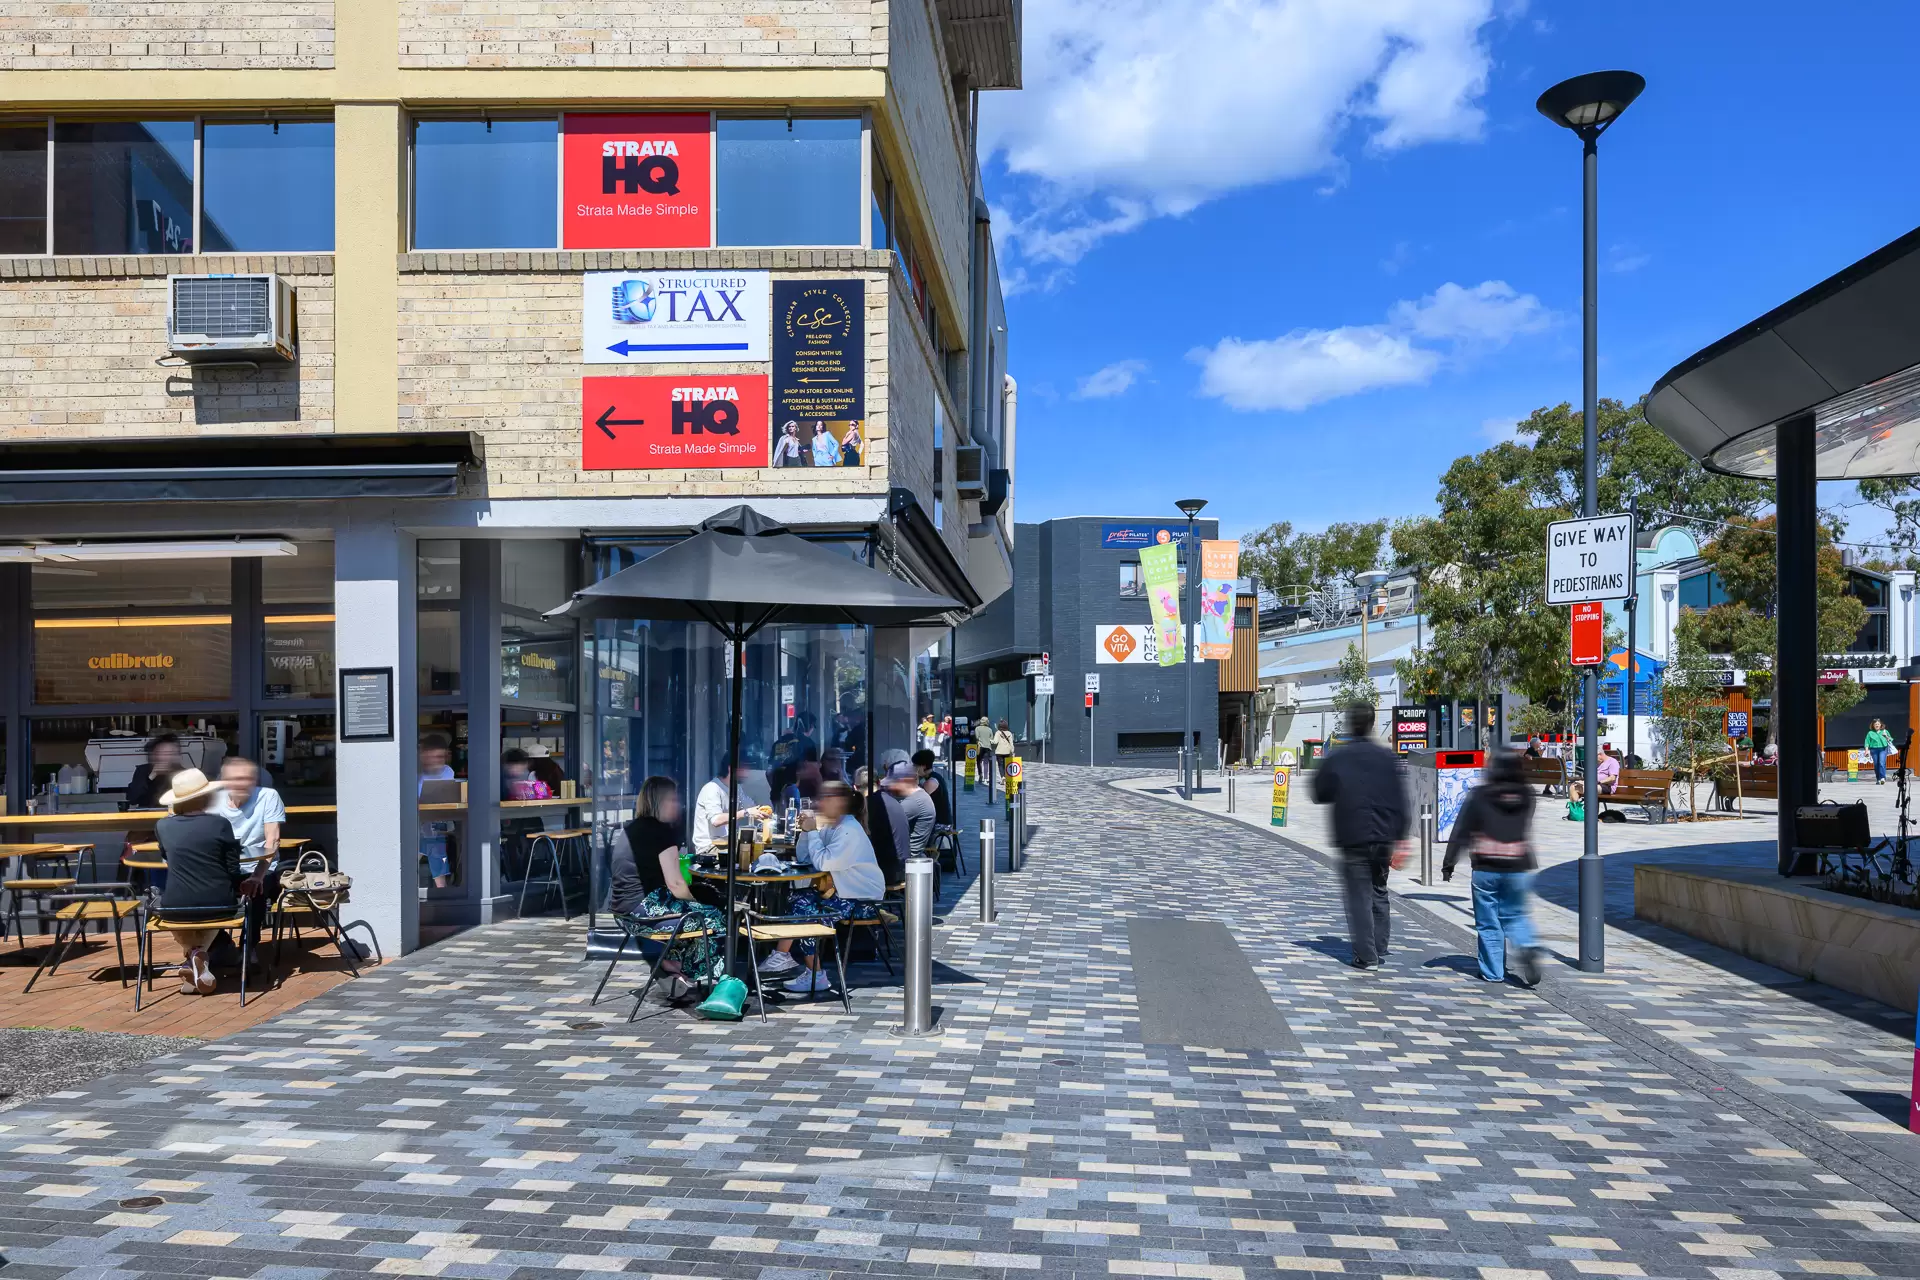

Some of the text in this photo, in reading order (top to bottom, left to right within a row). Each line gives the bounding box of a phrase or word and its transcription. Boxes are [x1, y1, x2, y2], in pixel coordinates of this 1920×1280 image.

[602, 140, 679, 156] STRATA
[602, 155, 680, 196] HQ
[577, 203, 698, 217] Strata Made Simple
[658, 290, 747, 322] TAX
[786, 289, 850, 338] CIRCULAR STYLE COLLECTIVE
[672, 387, 739, 401] STRATA
[672, 400, 740, 436] HQ
[649, 442, 756, 455] Strata Made Simple
[1554, 525, 1626, 547] GIVE WAY
[1580, 552, 1597, 568] TO
[1554, 574, 1623, 594] PEDESTRIANS
[1575, 614, 1599, 622] STOPPING
[1112, 634, 1128, 643] GO
[1110, 644, 1130, 652] VITA
[88, 652, 174, 669] calibrate
[522, 652, 556, 670] calibrate
[98, 674, 166, 682] BIRDWOOD
[1826, 672, 1844, 681] Delight
[1398, 723, 1426, 732] coles
[1009, 764, 1017, 774] 10
[1277, 775, 1283, 783] 10
